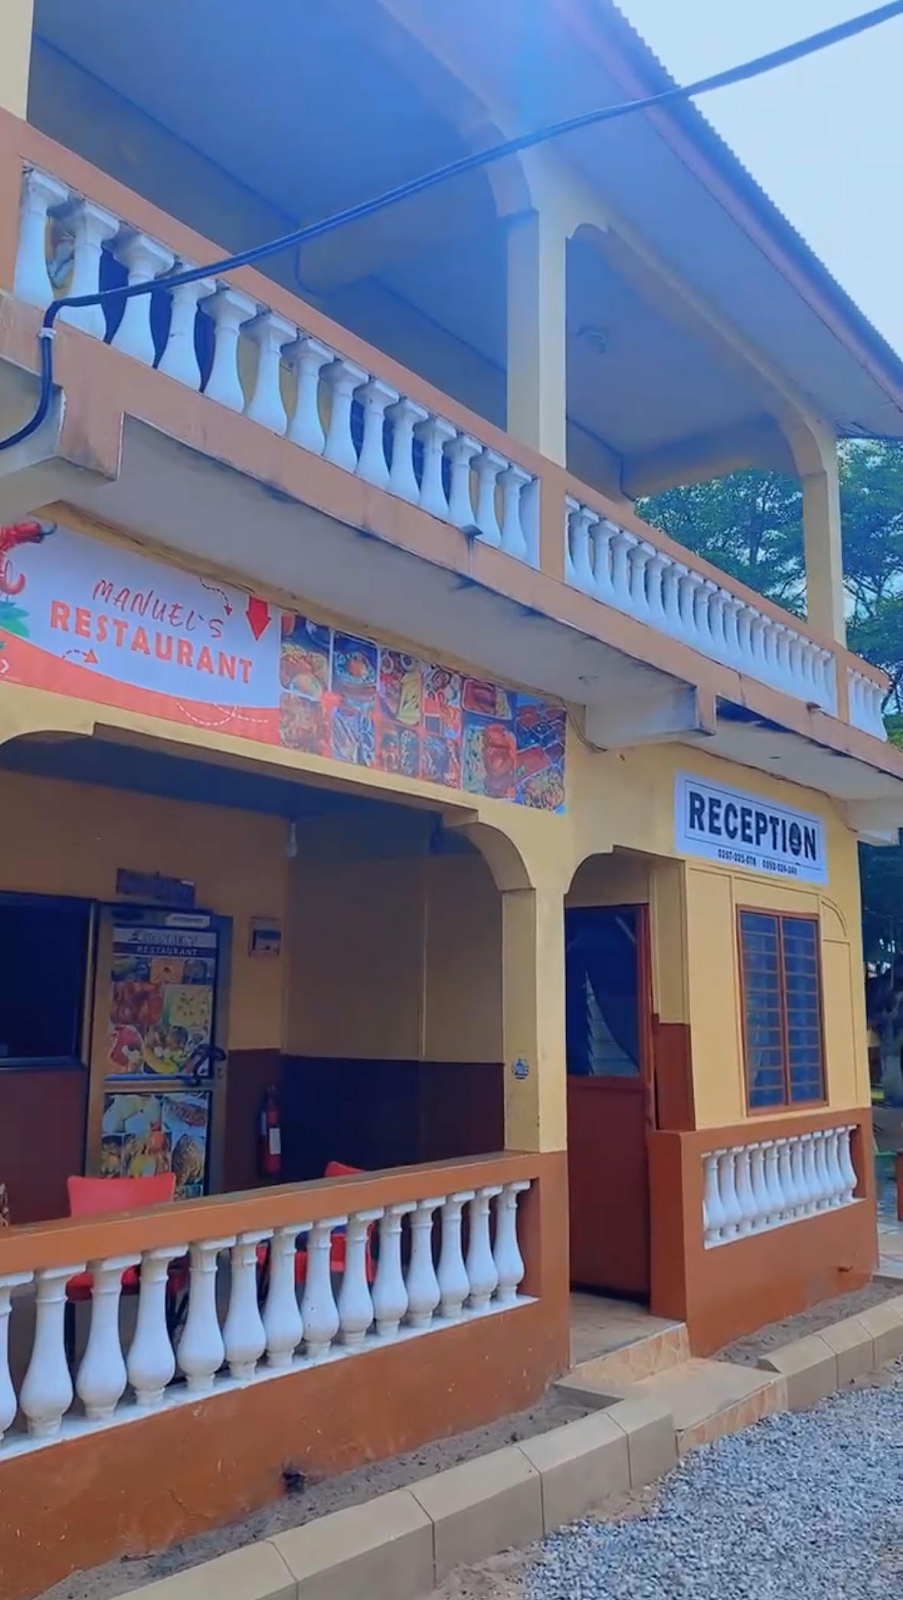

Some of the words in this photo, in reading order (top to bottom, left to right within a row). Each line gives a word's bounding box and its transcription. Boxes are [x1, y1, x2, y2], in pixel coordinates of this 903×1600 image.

[50, 599, 253, 683] RESTAURANT
[688, 790, 817, 862] RECEPTION
[136, 945, 198, 956] RESTAURANT
